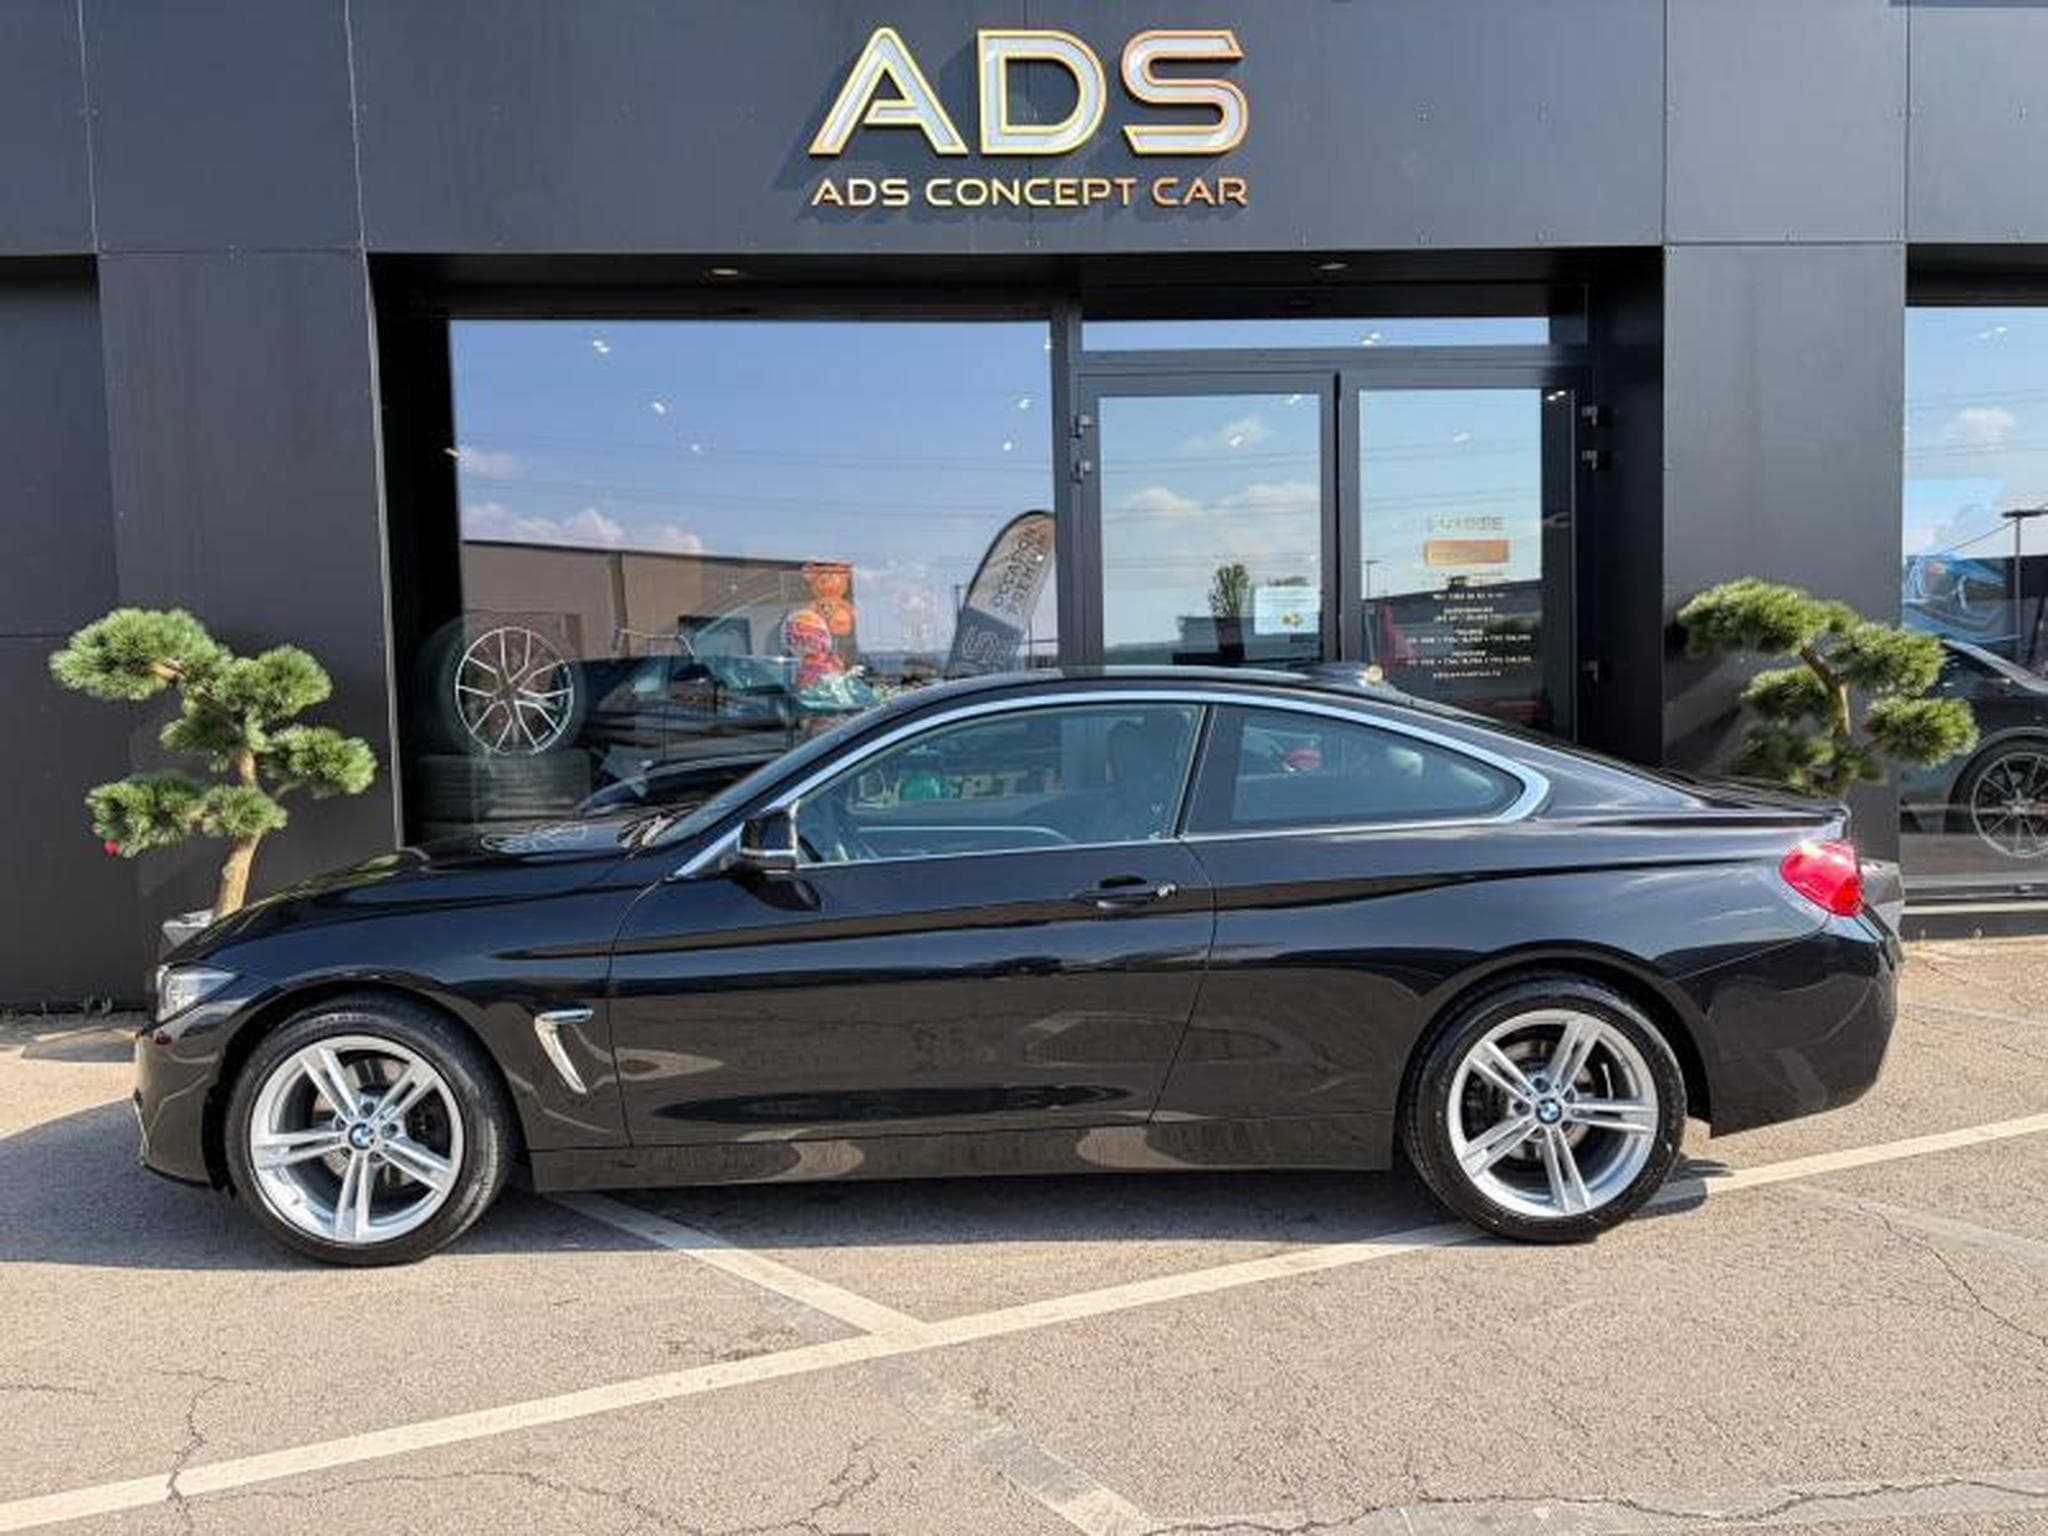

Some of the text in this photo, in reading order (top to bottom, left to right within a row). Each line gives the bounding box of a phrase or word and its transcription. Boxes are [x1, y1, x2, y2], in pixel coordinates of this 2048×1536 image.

[808, 27, 1249, 155] ADS
[811, 177, 1249, 206] ADS CONCEPT CAR
